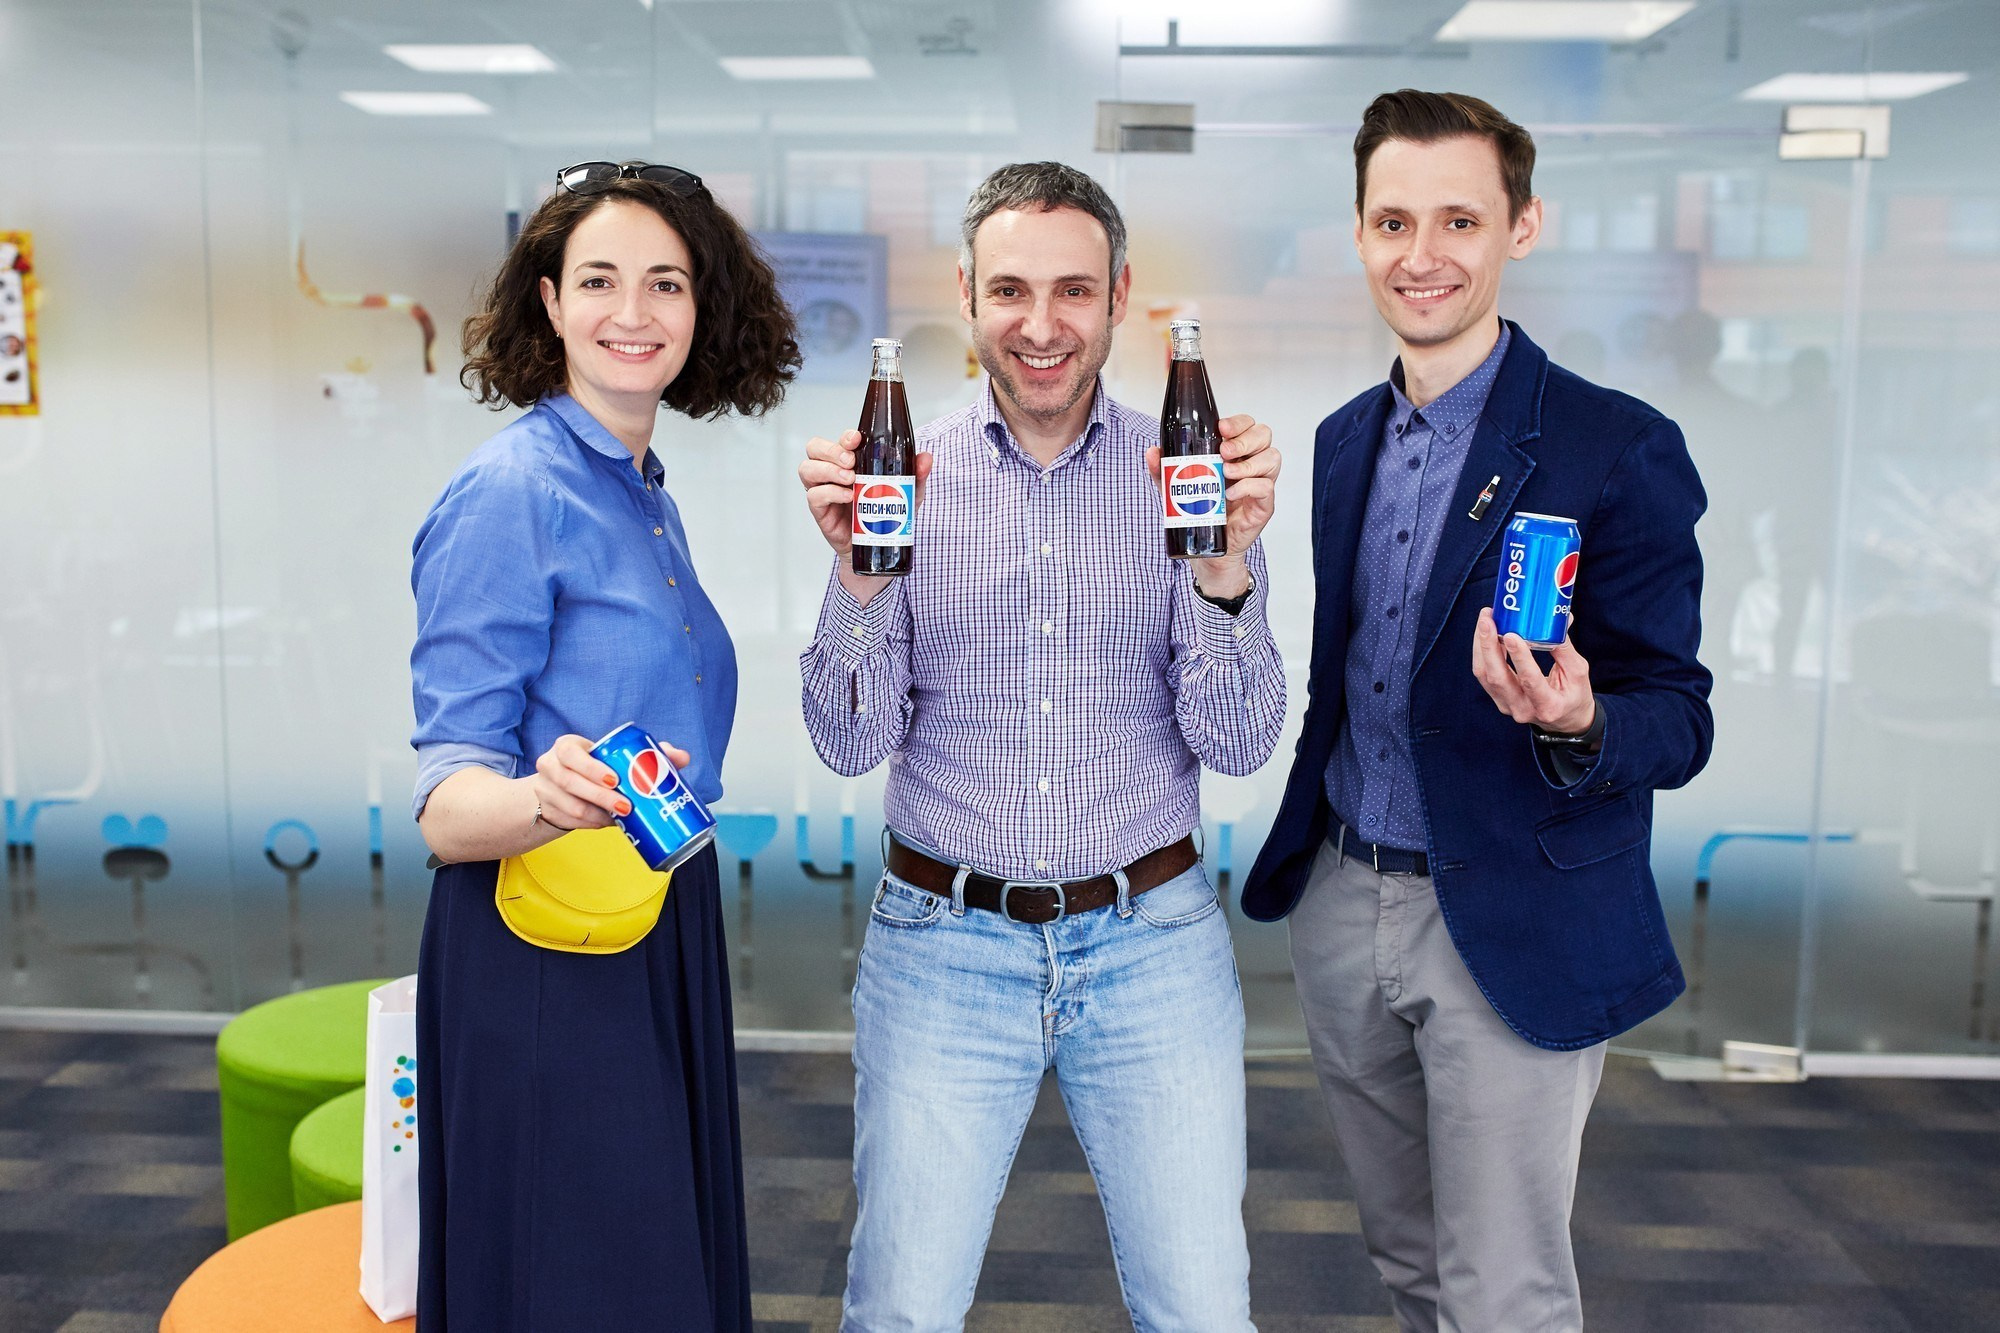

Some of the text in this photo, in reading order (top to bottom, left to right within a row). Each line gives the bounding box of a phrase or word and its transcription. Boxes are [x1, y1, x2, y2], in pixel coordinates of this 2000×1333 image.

[1171, 482, 1221, 496] ПЕПСИ-КОЛА
[857, 502, 907, 515] ПЕПСИ-КОЛА
[1503, 542, 1526, 612] pepsi
